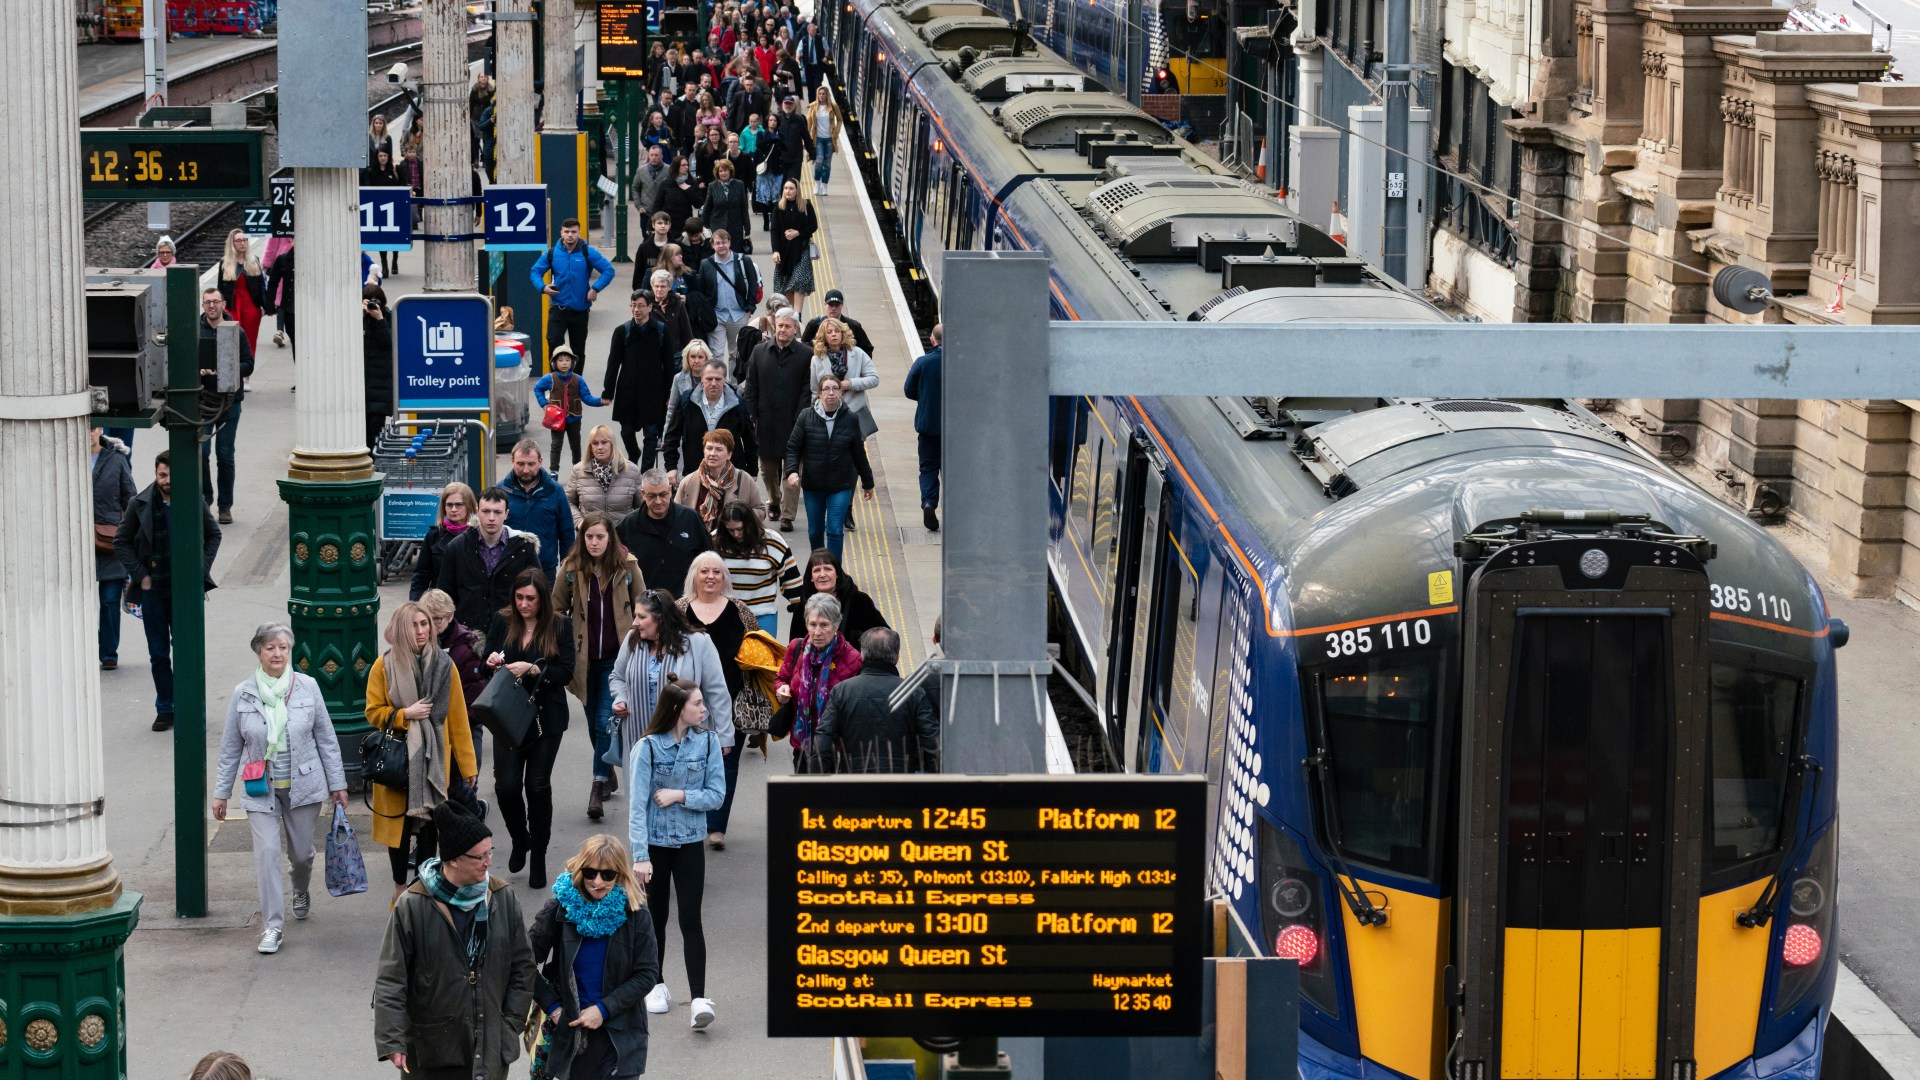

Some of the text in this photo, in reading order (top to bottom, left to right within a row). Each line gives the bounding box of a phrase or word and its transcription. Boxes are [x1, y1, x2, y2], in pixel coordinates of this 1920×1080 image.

[1214, 79, 1226, 87] 33
[245, 209, 271, 226] ZZ
[281, 209, 292, 228] 4
[360, 201, 401, 232] 11
[494, 201, 537, 232] 12
[406, 375, 481, 389] Trolley point
[1709, 583, 1792, 622] 385 110
[1325, 619, 1432, 658] 385 110
[801, 808, 1177, 832] 1st departure 12:45 Platform 12
[797, 840, 1010, 865] Glasgow Queen St
[797, 870, 848, 887] Calling
[853, 870, 876, 884] at:
[914, 870, 975, 884] Polmont
[981, 870, 1036, 887] (13:10),
[1041, 870, 1095, 884] Falkirk
[1100, 870, 1131, 888] High
[797, 890, 1036, 906] ScotRail Express
[797, 912, 1174, 936] 2nd departure 13:00 Platform 12
[797, 944, 1008, 968] Glasgow Queen St
[796, 973, 1174, 991] Calling at: Haymarket
[797, 993, 1034, 1009] ScotRail Express
